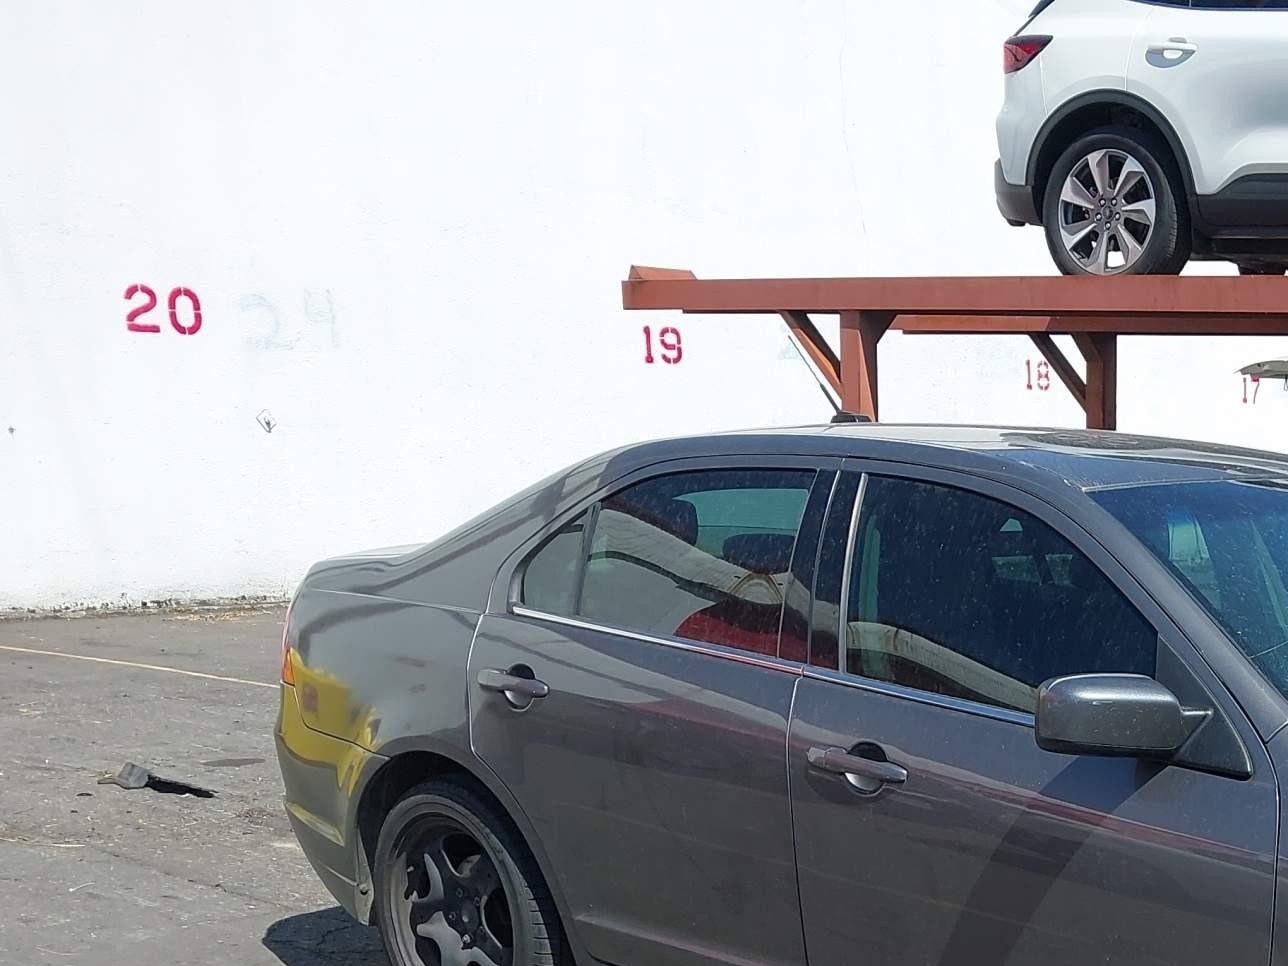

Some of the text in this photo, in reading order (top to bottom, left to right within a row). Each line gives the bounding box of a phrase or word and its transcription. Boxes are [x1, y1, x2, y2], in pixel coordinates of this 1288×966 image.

[124, 284, 203, 336] 20
[643, 326, 682, 364] 19
[1025, 359, 1050, 391] 18
[1241, 375, 1260, 404] 17
